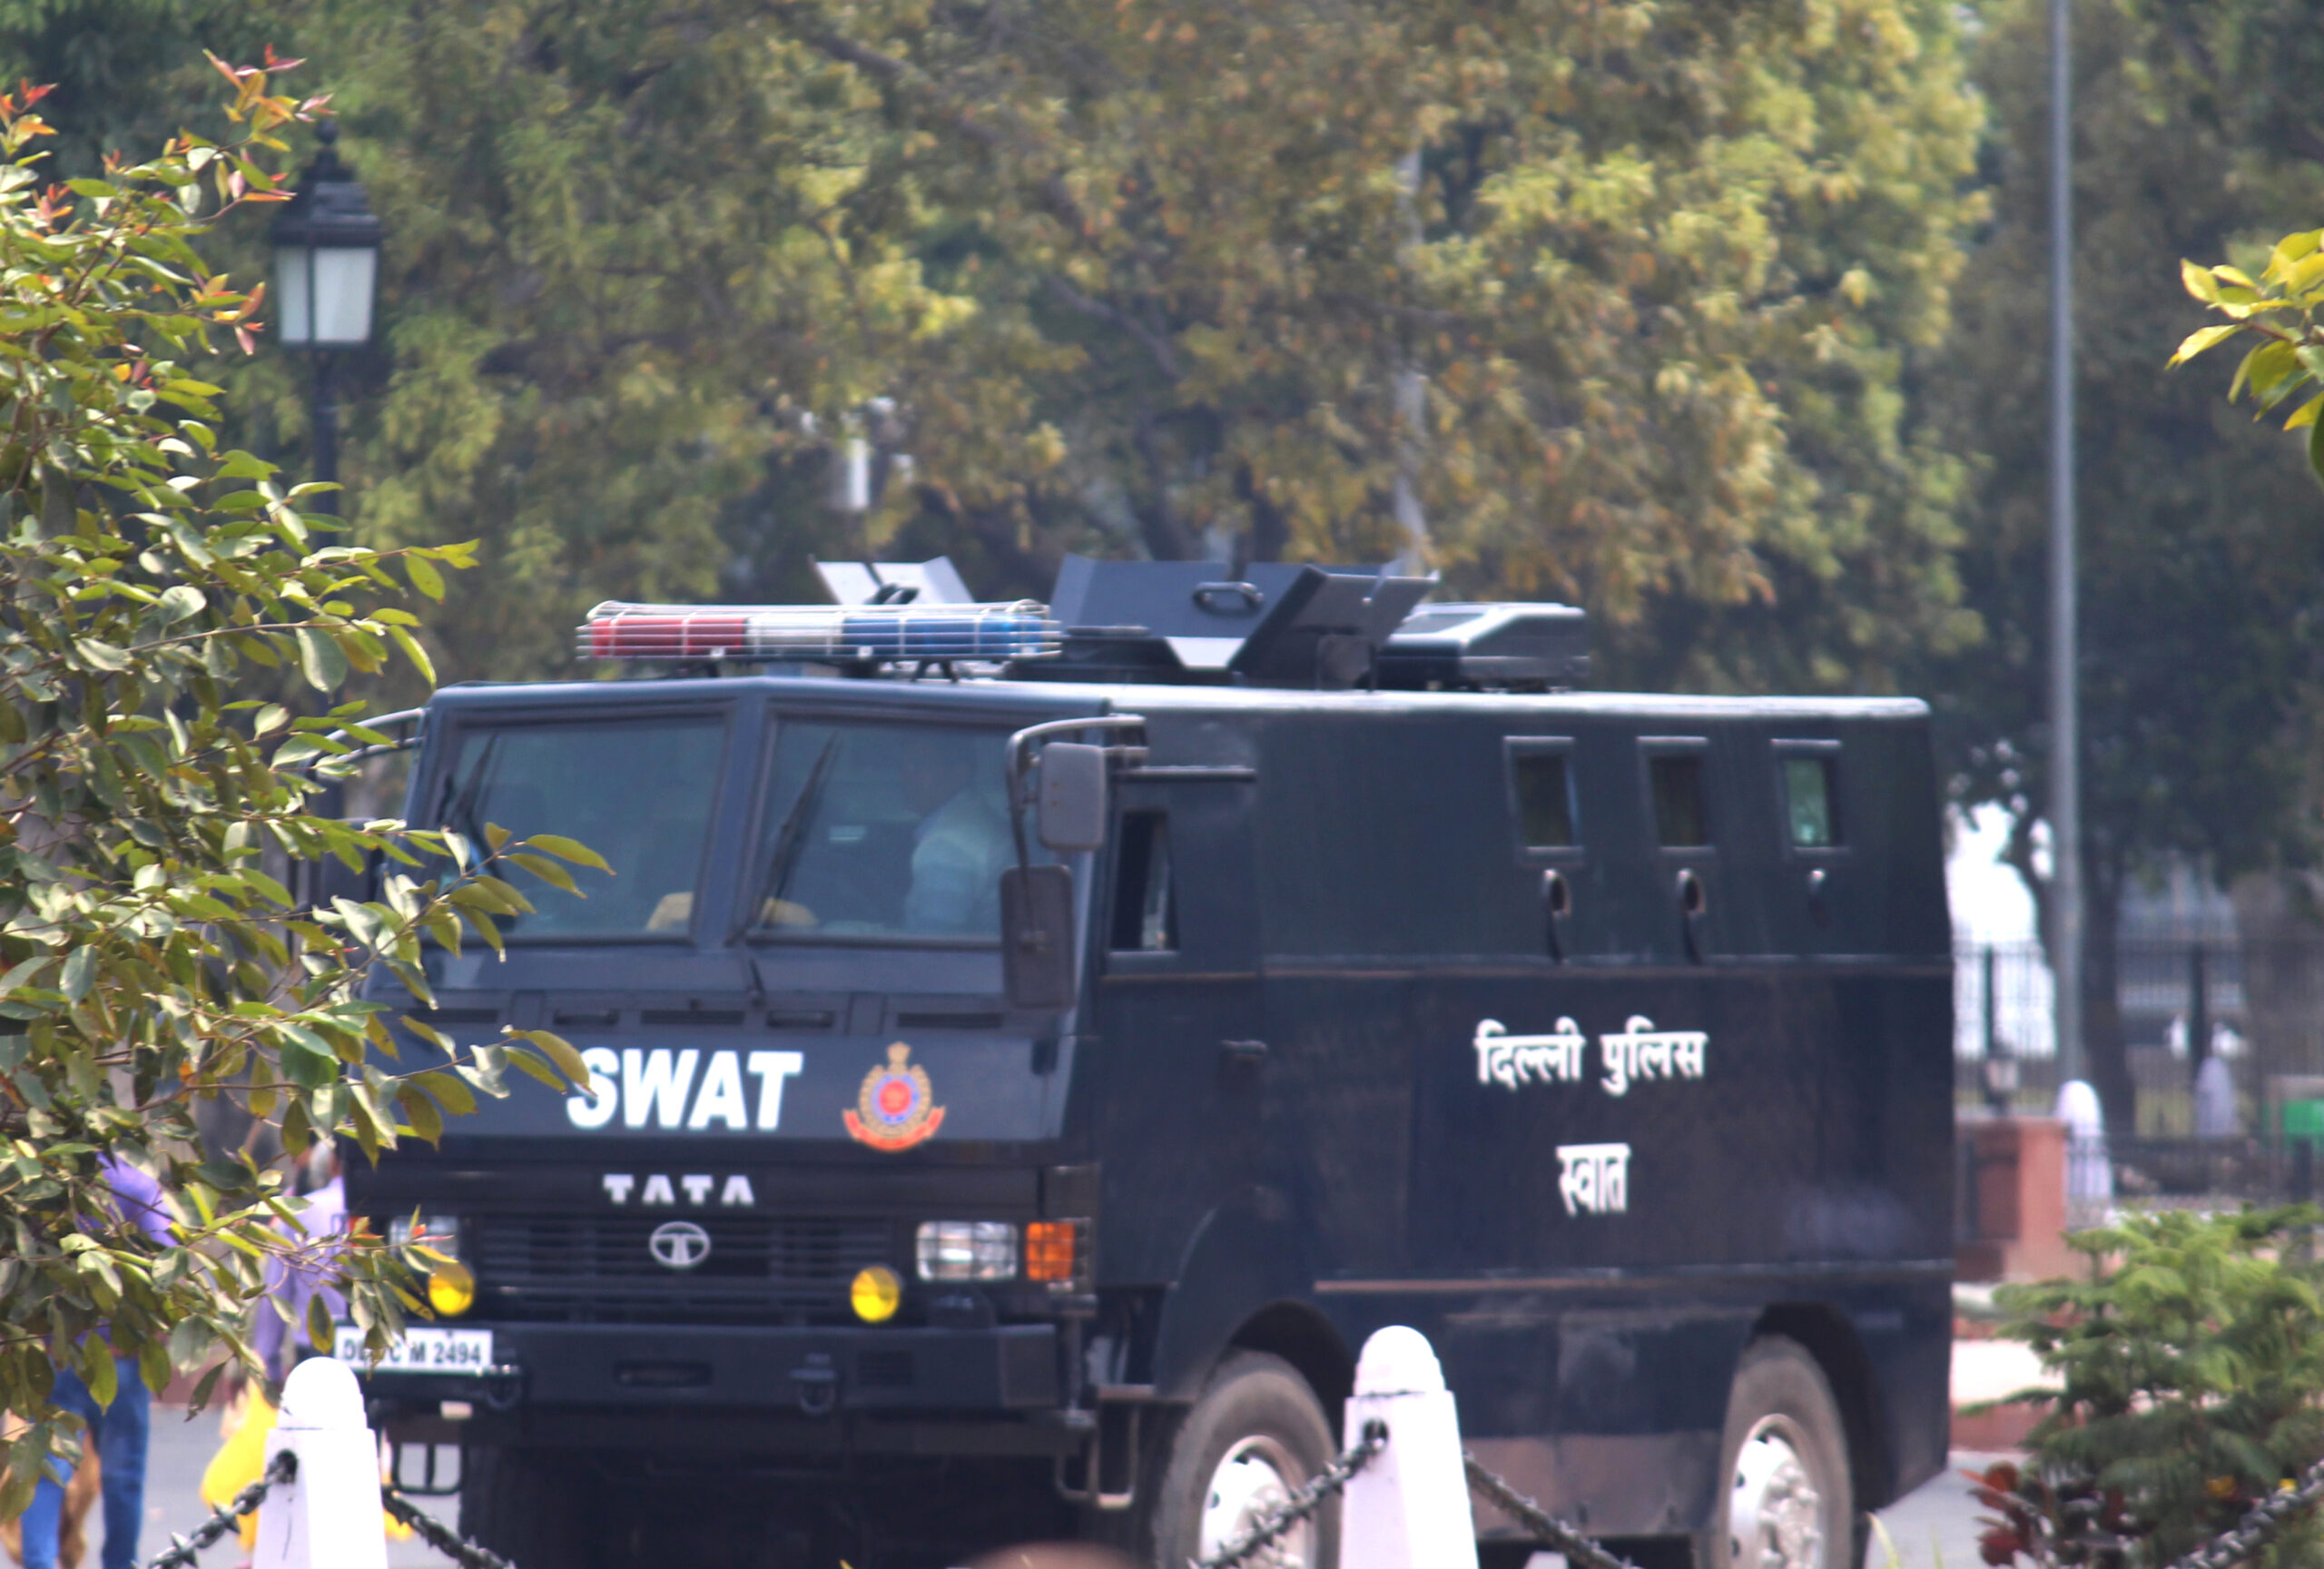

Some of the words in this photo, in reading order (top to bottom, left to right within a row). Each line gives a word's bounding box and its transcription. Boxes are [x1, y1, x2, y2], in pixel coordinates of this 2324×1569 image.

[566, 1047, 803, 1130] SWAT
[1472, 1016, 1587, 1090] दिल्ली
[1600, 1014, 1709, 1095] पुलिस
[603, 1174, 754, 1204] TATA
[1556, 1142, 1631, 1216] स्वात
[433, 1341, 482, 1365] 2494
